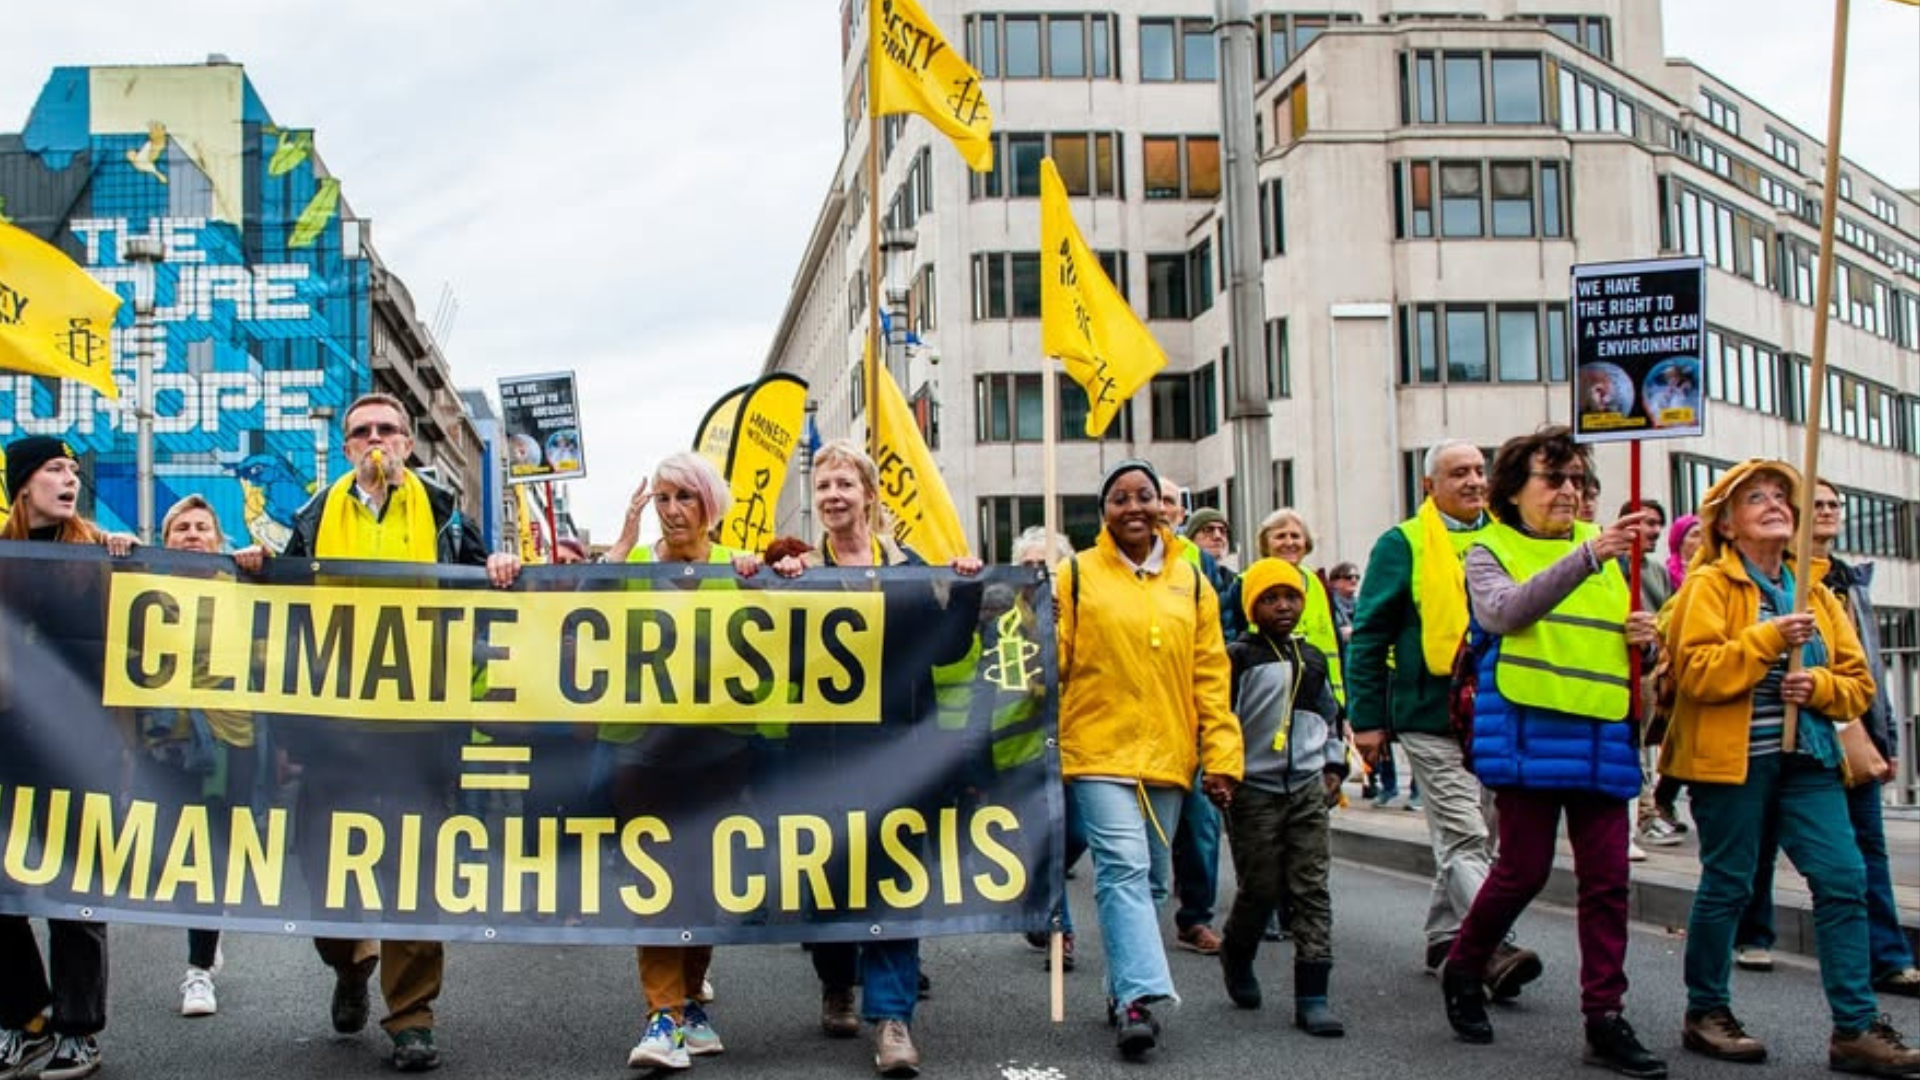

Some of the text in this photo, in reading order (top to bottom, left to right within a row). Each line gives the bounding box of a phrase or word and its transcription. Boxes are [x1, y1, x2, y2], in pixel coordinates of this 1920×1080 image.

[70, 216, 206, 264] THE
[80, 264, 310, 321] TURE
[1578, 276, 1641, 298] WE HAVE
[1578, 295, 1674, 317] THE RIGHT TO
[1585, 314, 1698, 338] A SAFE & CLEAN
[1598, 334, 1698, 357] ENVIRONMENT
[0, 370, 324, 435] UROPE
[749, 410, 792, 449] AMNEST
[125, 589, 869, 706] CLIMATE CRISIS
[0, 785, 1028, 916] UMAN RIGHTS CRISIS
